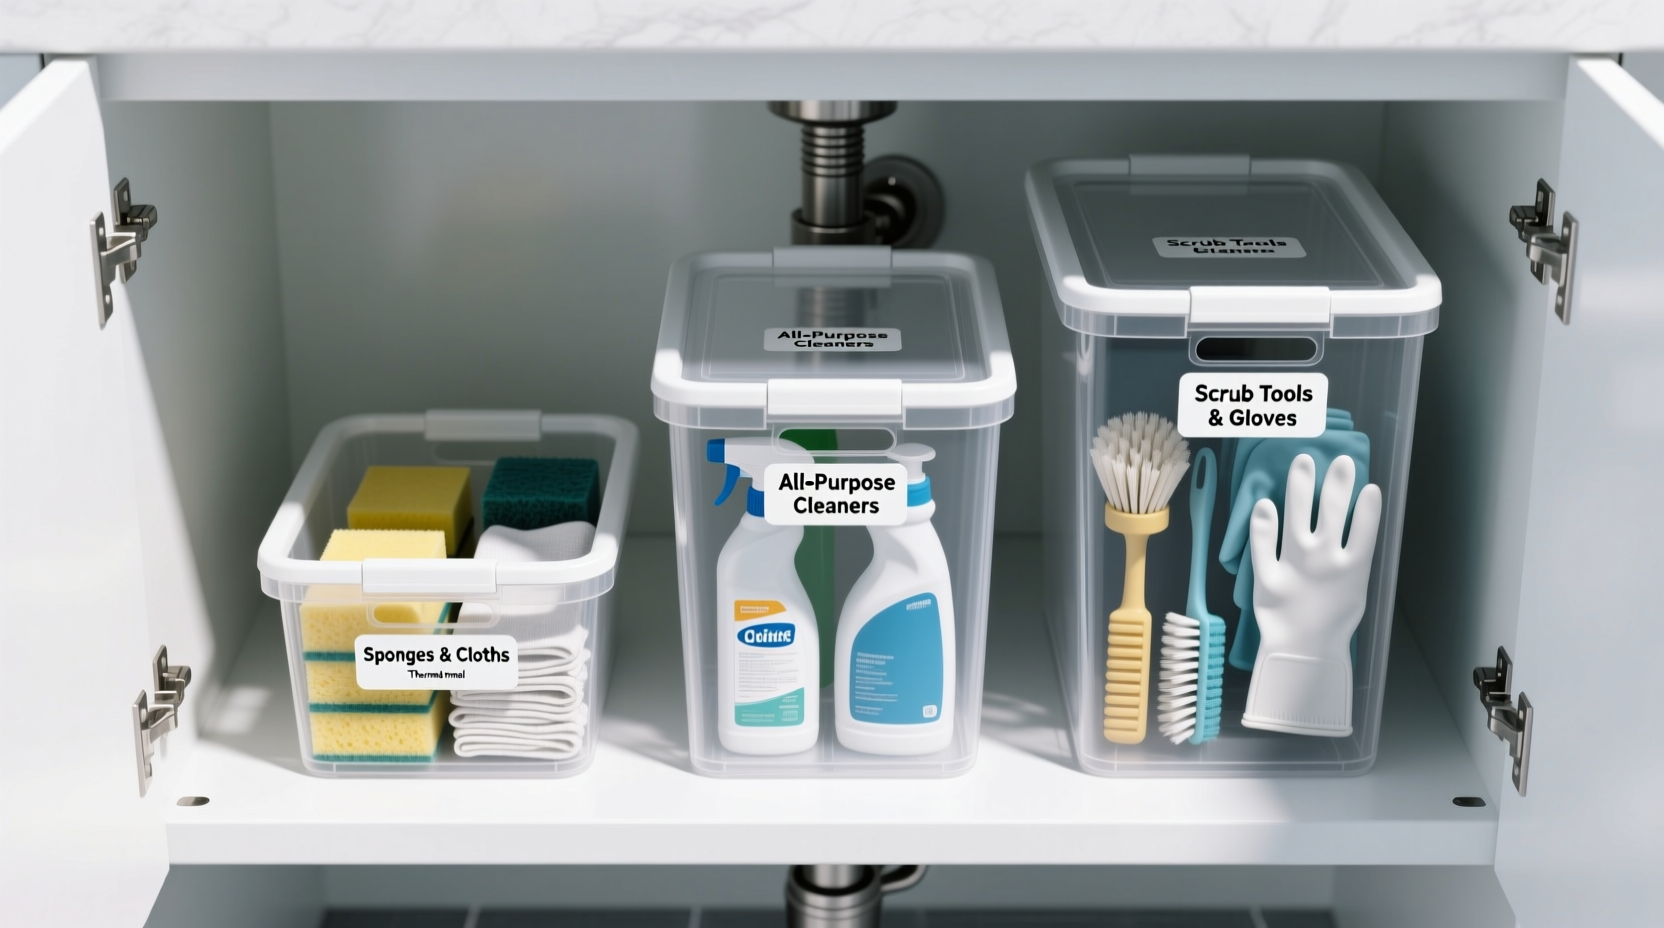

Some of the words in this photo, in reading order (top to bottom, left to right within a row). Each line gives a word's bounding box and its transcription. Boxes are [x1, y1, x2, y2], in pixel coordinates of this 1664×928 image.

[778, 330, 888, 341] All-Purpose
[1195, 384, 1254, 402] Scrub
[1259, 384, 1313, 402] Tools
[1208, 408, 1223, 426] &
[1229, 409, 1297, 426] Gloves
[778, 472, 896, 495] All-Purpose
[793, 496, 880, 514] Cleaners
[363, 646, 435, 666] Sponges
[439, 647, 452, 662] &
[456, 646, 510, 662] Cloths
